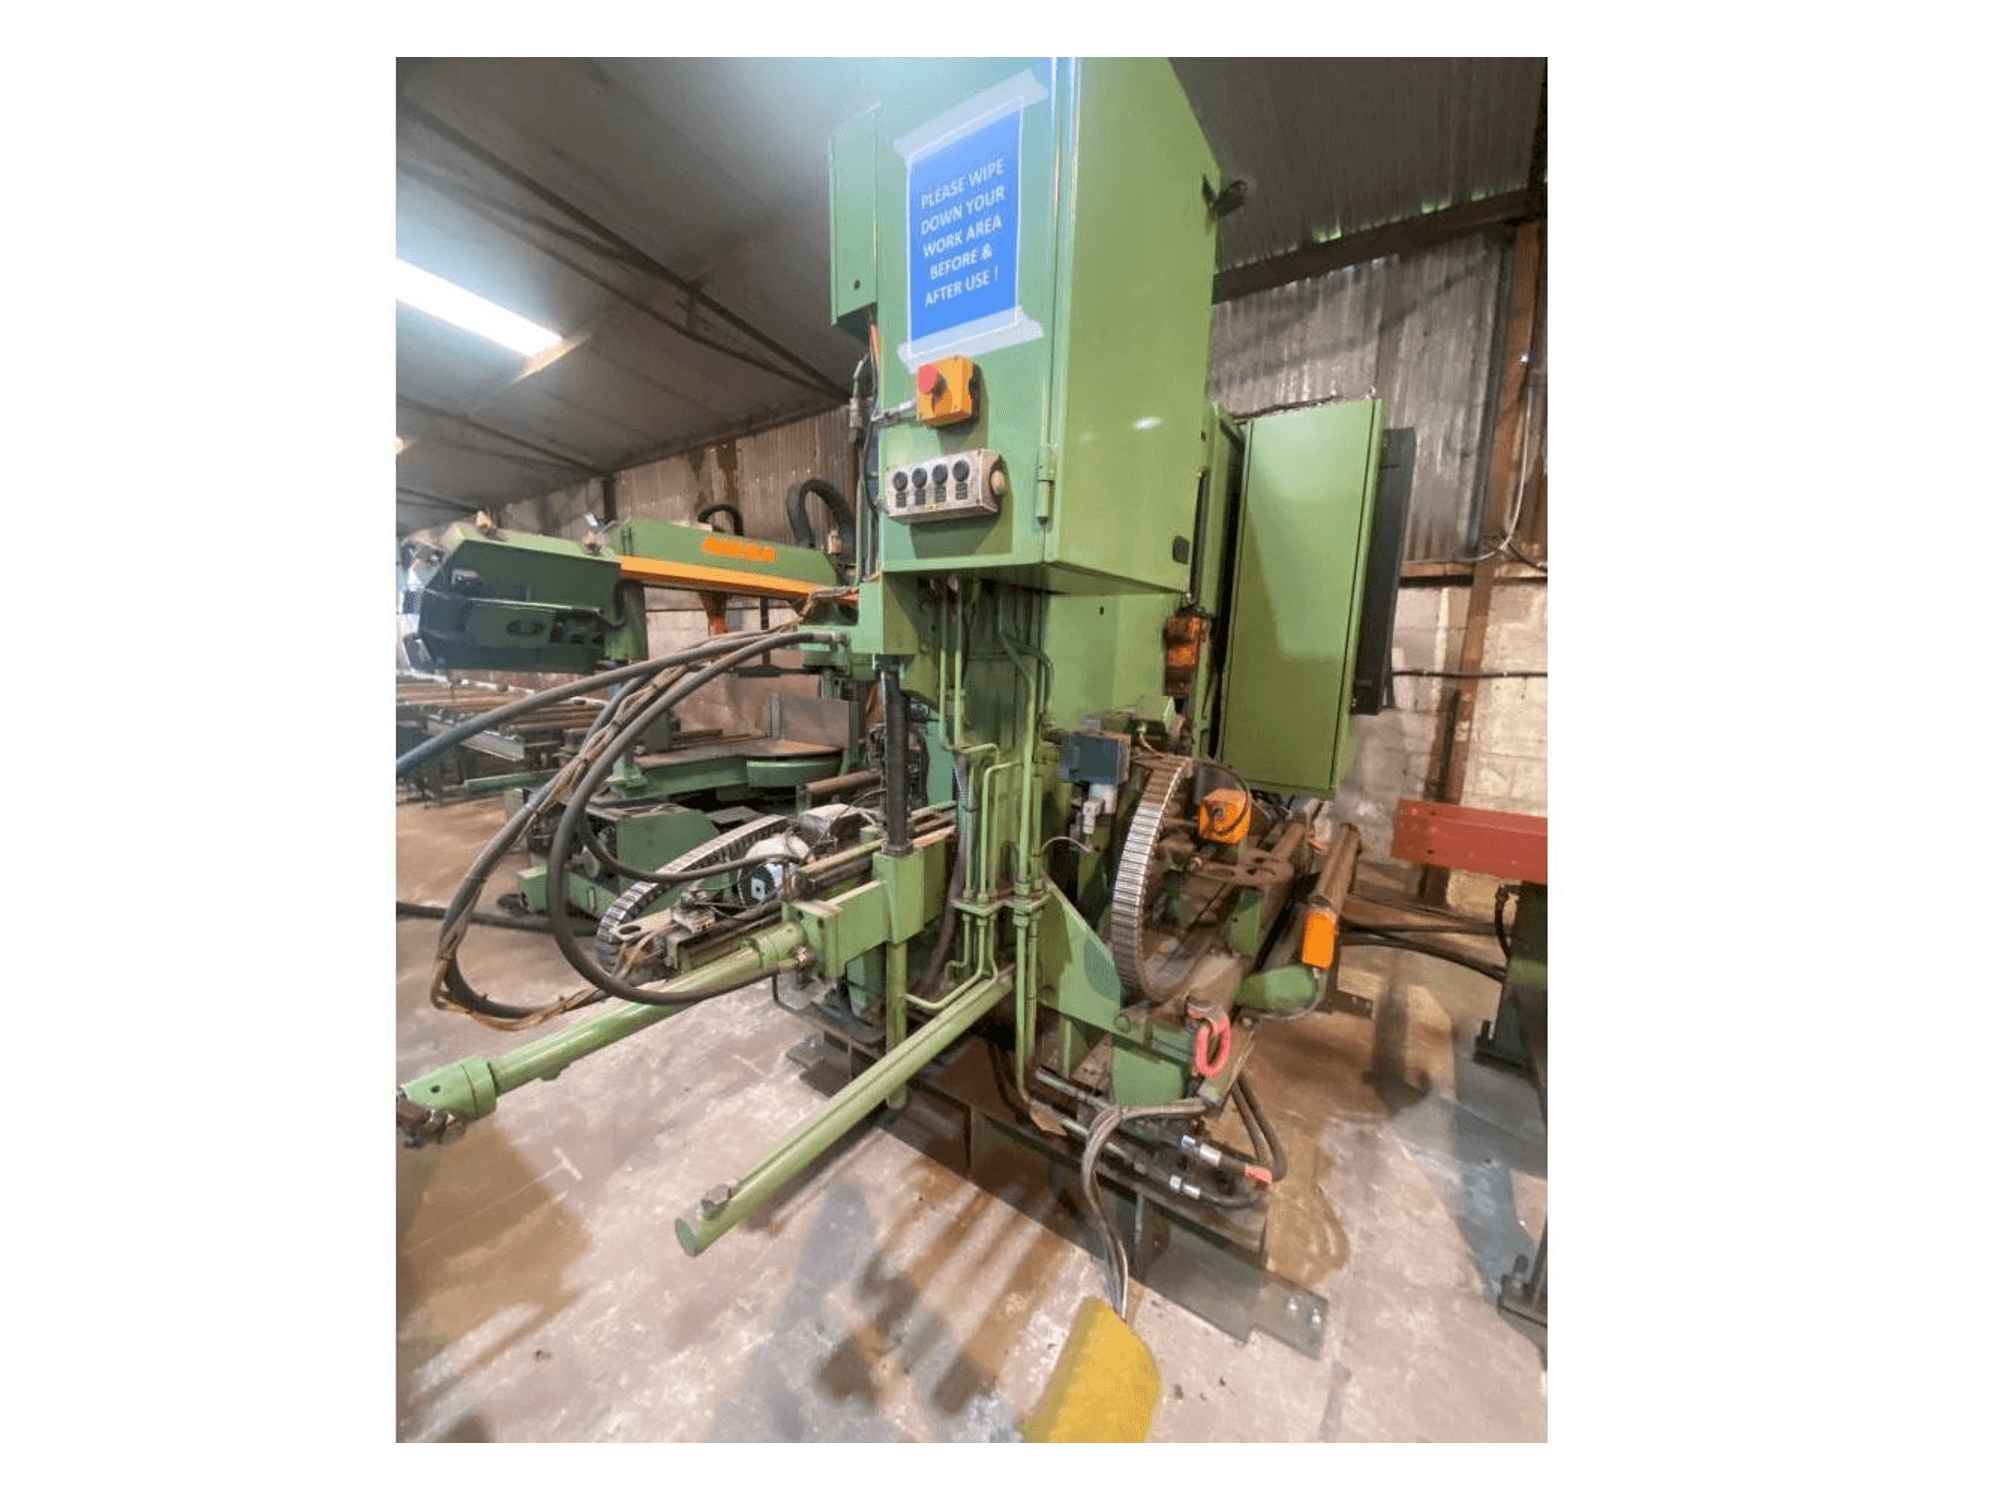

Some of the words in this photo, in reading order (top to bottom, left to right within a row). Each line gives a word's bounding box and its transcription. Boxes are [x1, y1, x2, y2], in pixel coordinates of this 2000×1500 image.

[921, 176, 965, 210] PLEASE
[968, 158, 1004, 187] WIPE
[921, 203, 963, 235] DOWN
[966, 185, 1005, 215] YOUR
[923, 230, 963, 258] WORK
[966, 214, 1002, 242] AREA
[930, 249, 978, 280] BEFORE
[981, 243, 993, 260] &
[925, 281, 962, 308] AFTER
[965, 269, 990, 292] USE
[994, 264, 999, 282] !
